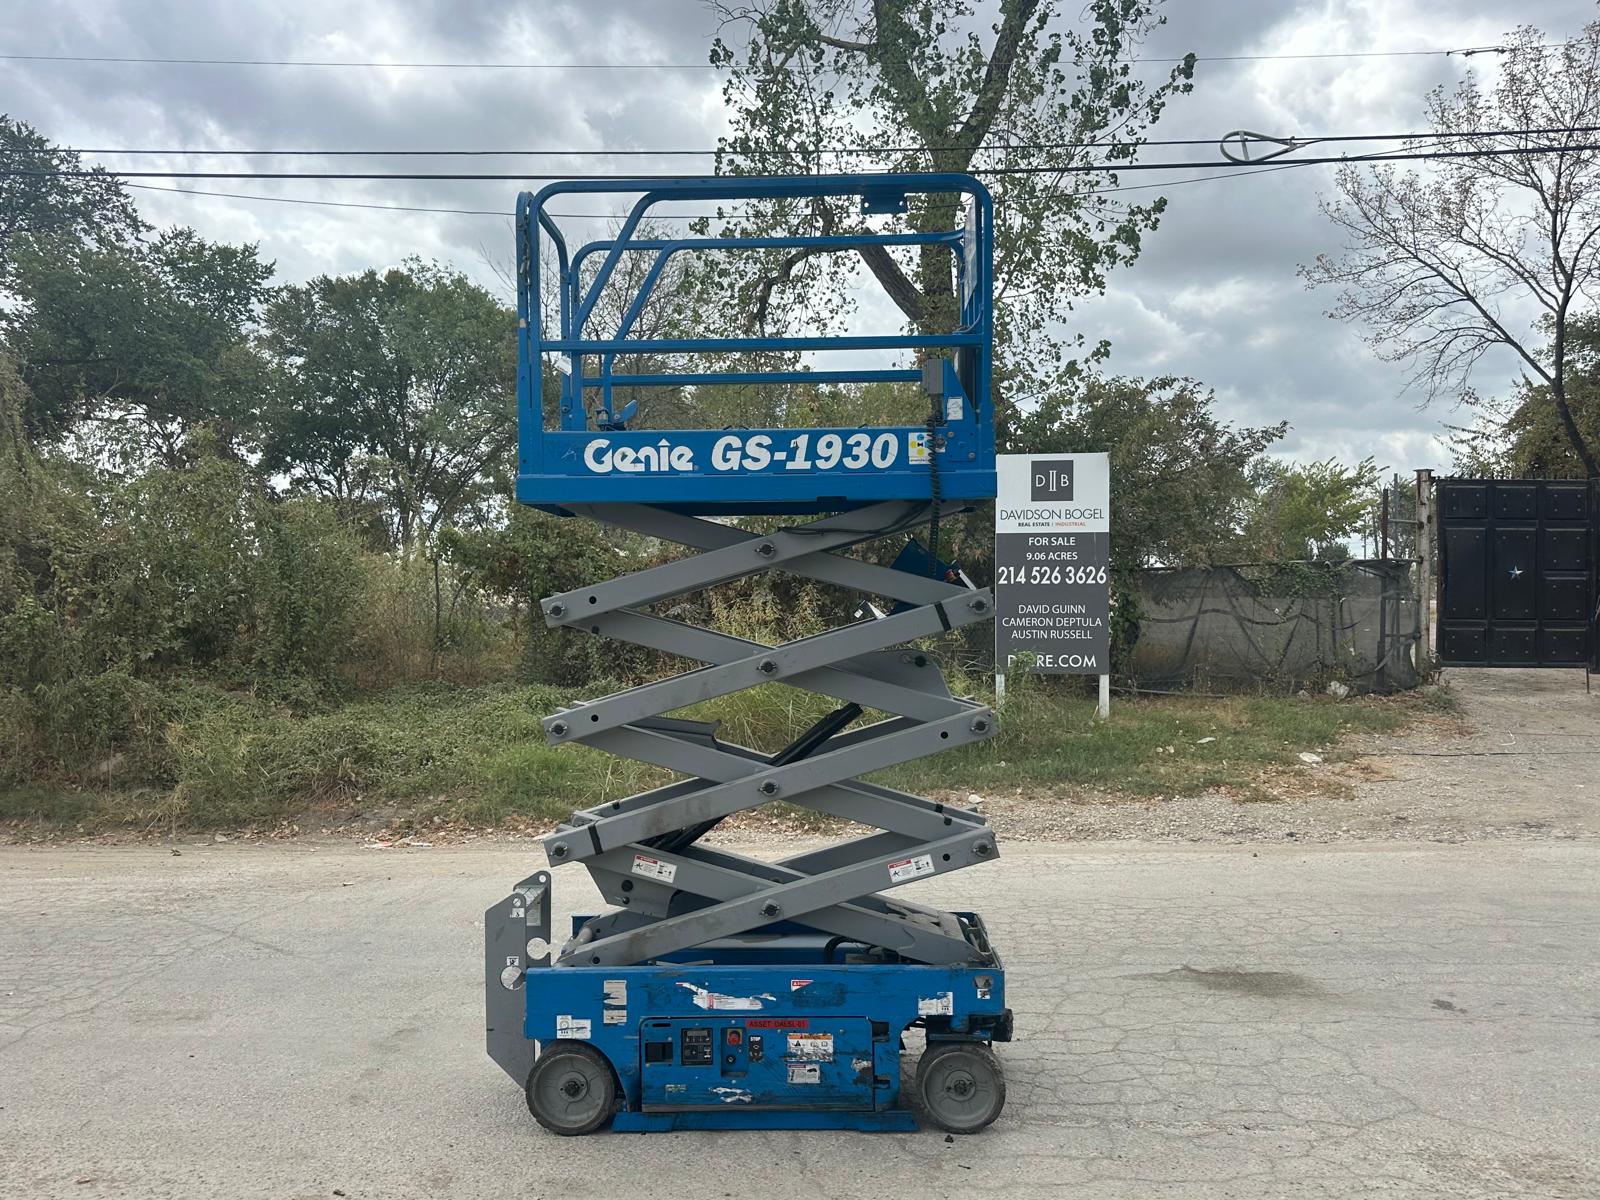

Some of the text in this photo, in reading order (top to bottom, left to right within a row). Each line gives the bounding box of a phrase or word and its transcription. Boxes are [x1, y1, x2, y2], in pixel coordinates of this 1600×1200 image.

[584, 433, 898, 473] Genie GS-1930
[1000, 508, 1105, 520] DAVIDSON BOGEL
[1028, 536, 1076, 546] FOR SALE
[1026, 551, 1078, 561] 9.06 ACRES
[998, 566, 1107, 585] 214 526 3626
[1018, 604, 1086, 614] DAVID GUINN
[1002, 617, 1103, 627] CAMERON DEPTULA
[1011, 629, 1093, 639] AUSTIN RUSSELL
[1007, 654, 1097, 668] DRE.COM
